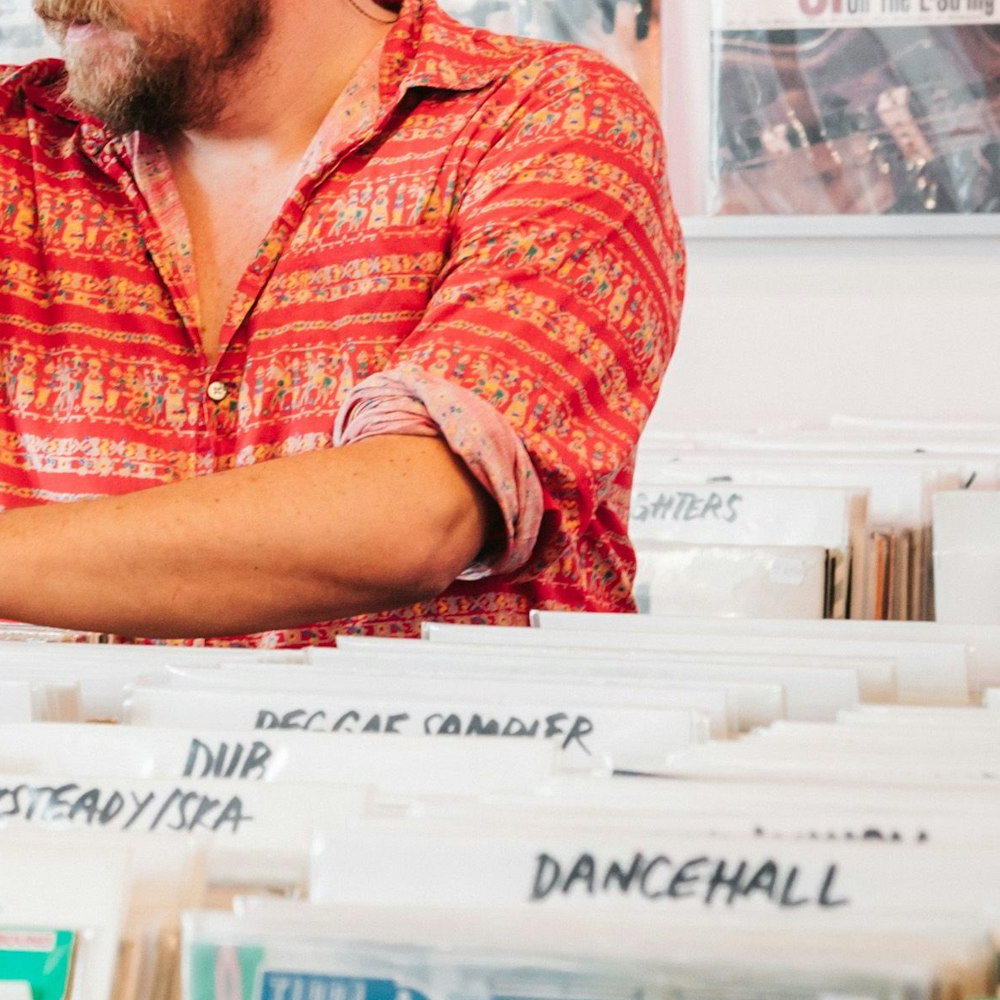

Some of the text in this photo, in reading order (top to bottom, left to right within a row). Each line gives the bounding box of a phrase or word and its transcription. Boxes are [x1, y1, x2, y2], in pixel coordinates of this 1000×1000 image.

[631, 491, 743, 523] GHTERS
[182, 738, 274, 778] DUB
[529, 851, 849, 908] DANCEHALL
